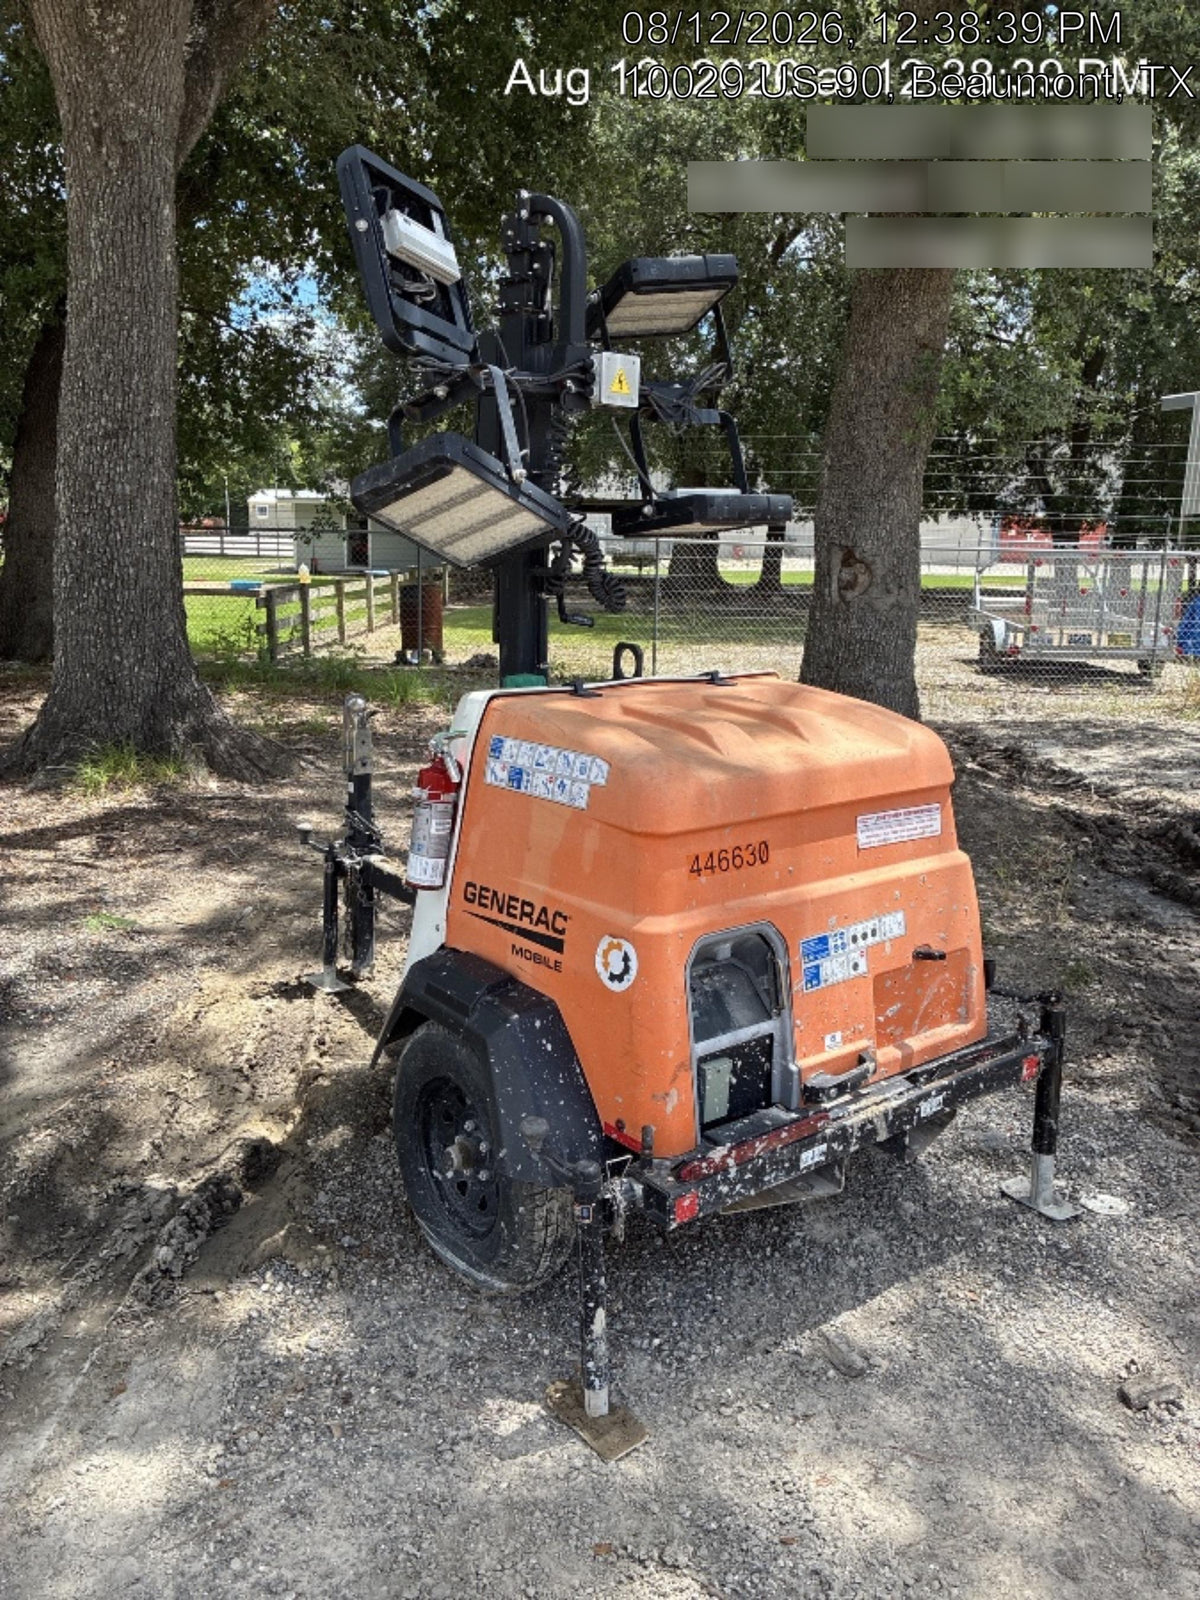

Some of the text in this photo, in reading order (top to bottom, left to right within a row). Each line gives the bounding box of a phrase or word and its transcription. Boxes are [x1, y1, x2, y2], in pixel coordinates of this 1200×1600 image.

[689, 840, 769, 877] 446630
[463, 881, 569, 936] GENERAC
[511, 943, 563, 973] MOBILE
